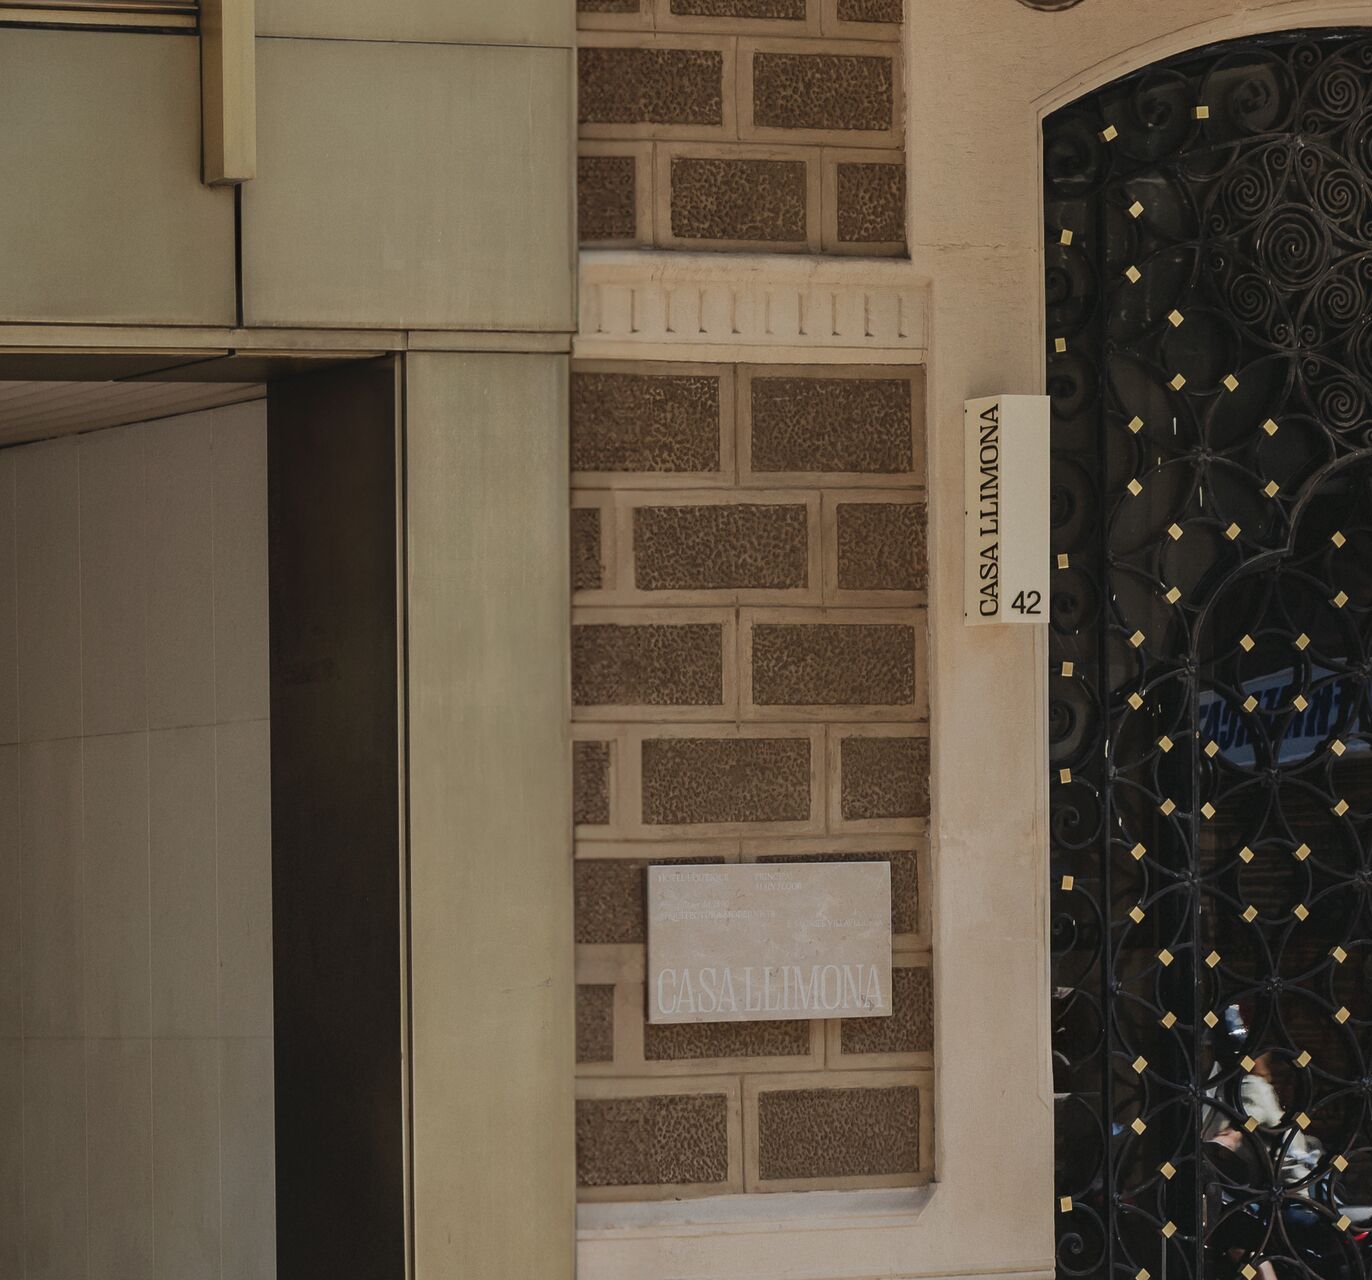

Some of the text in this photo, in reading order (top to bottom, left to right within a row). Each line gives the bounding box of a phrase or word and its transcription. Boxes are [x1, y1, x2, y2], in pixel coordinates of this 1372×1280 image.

[979, 403, 999, 617] CASA LLIMONA
[1011, 590, 1041, 614] 42
[657, 963, 885, 1014] CASA LLIMONA
